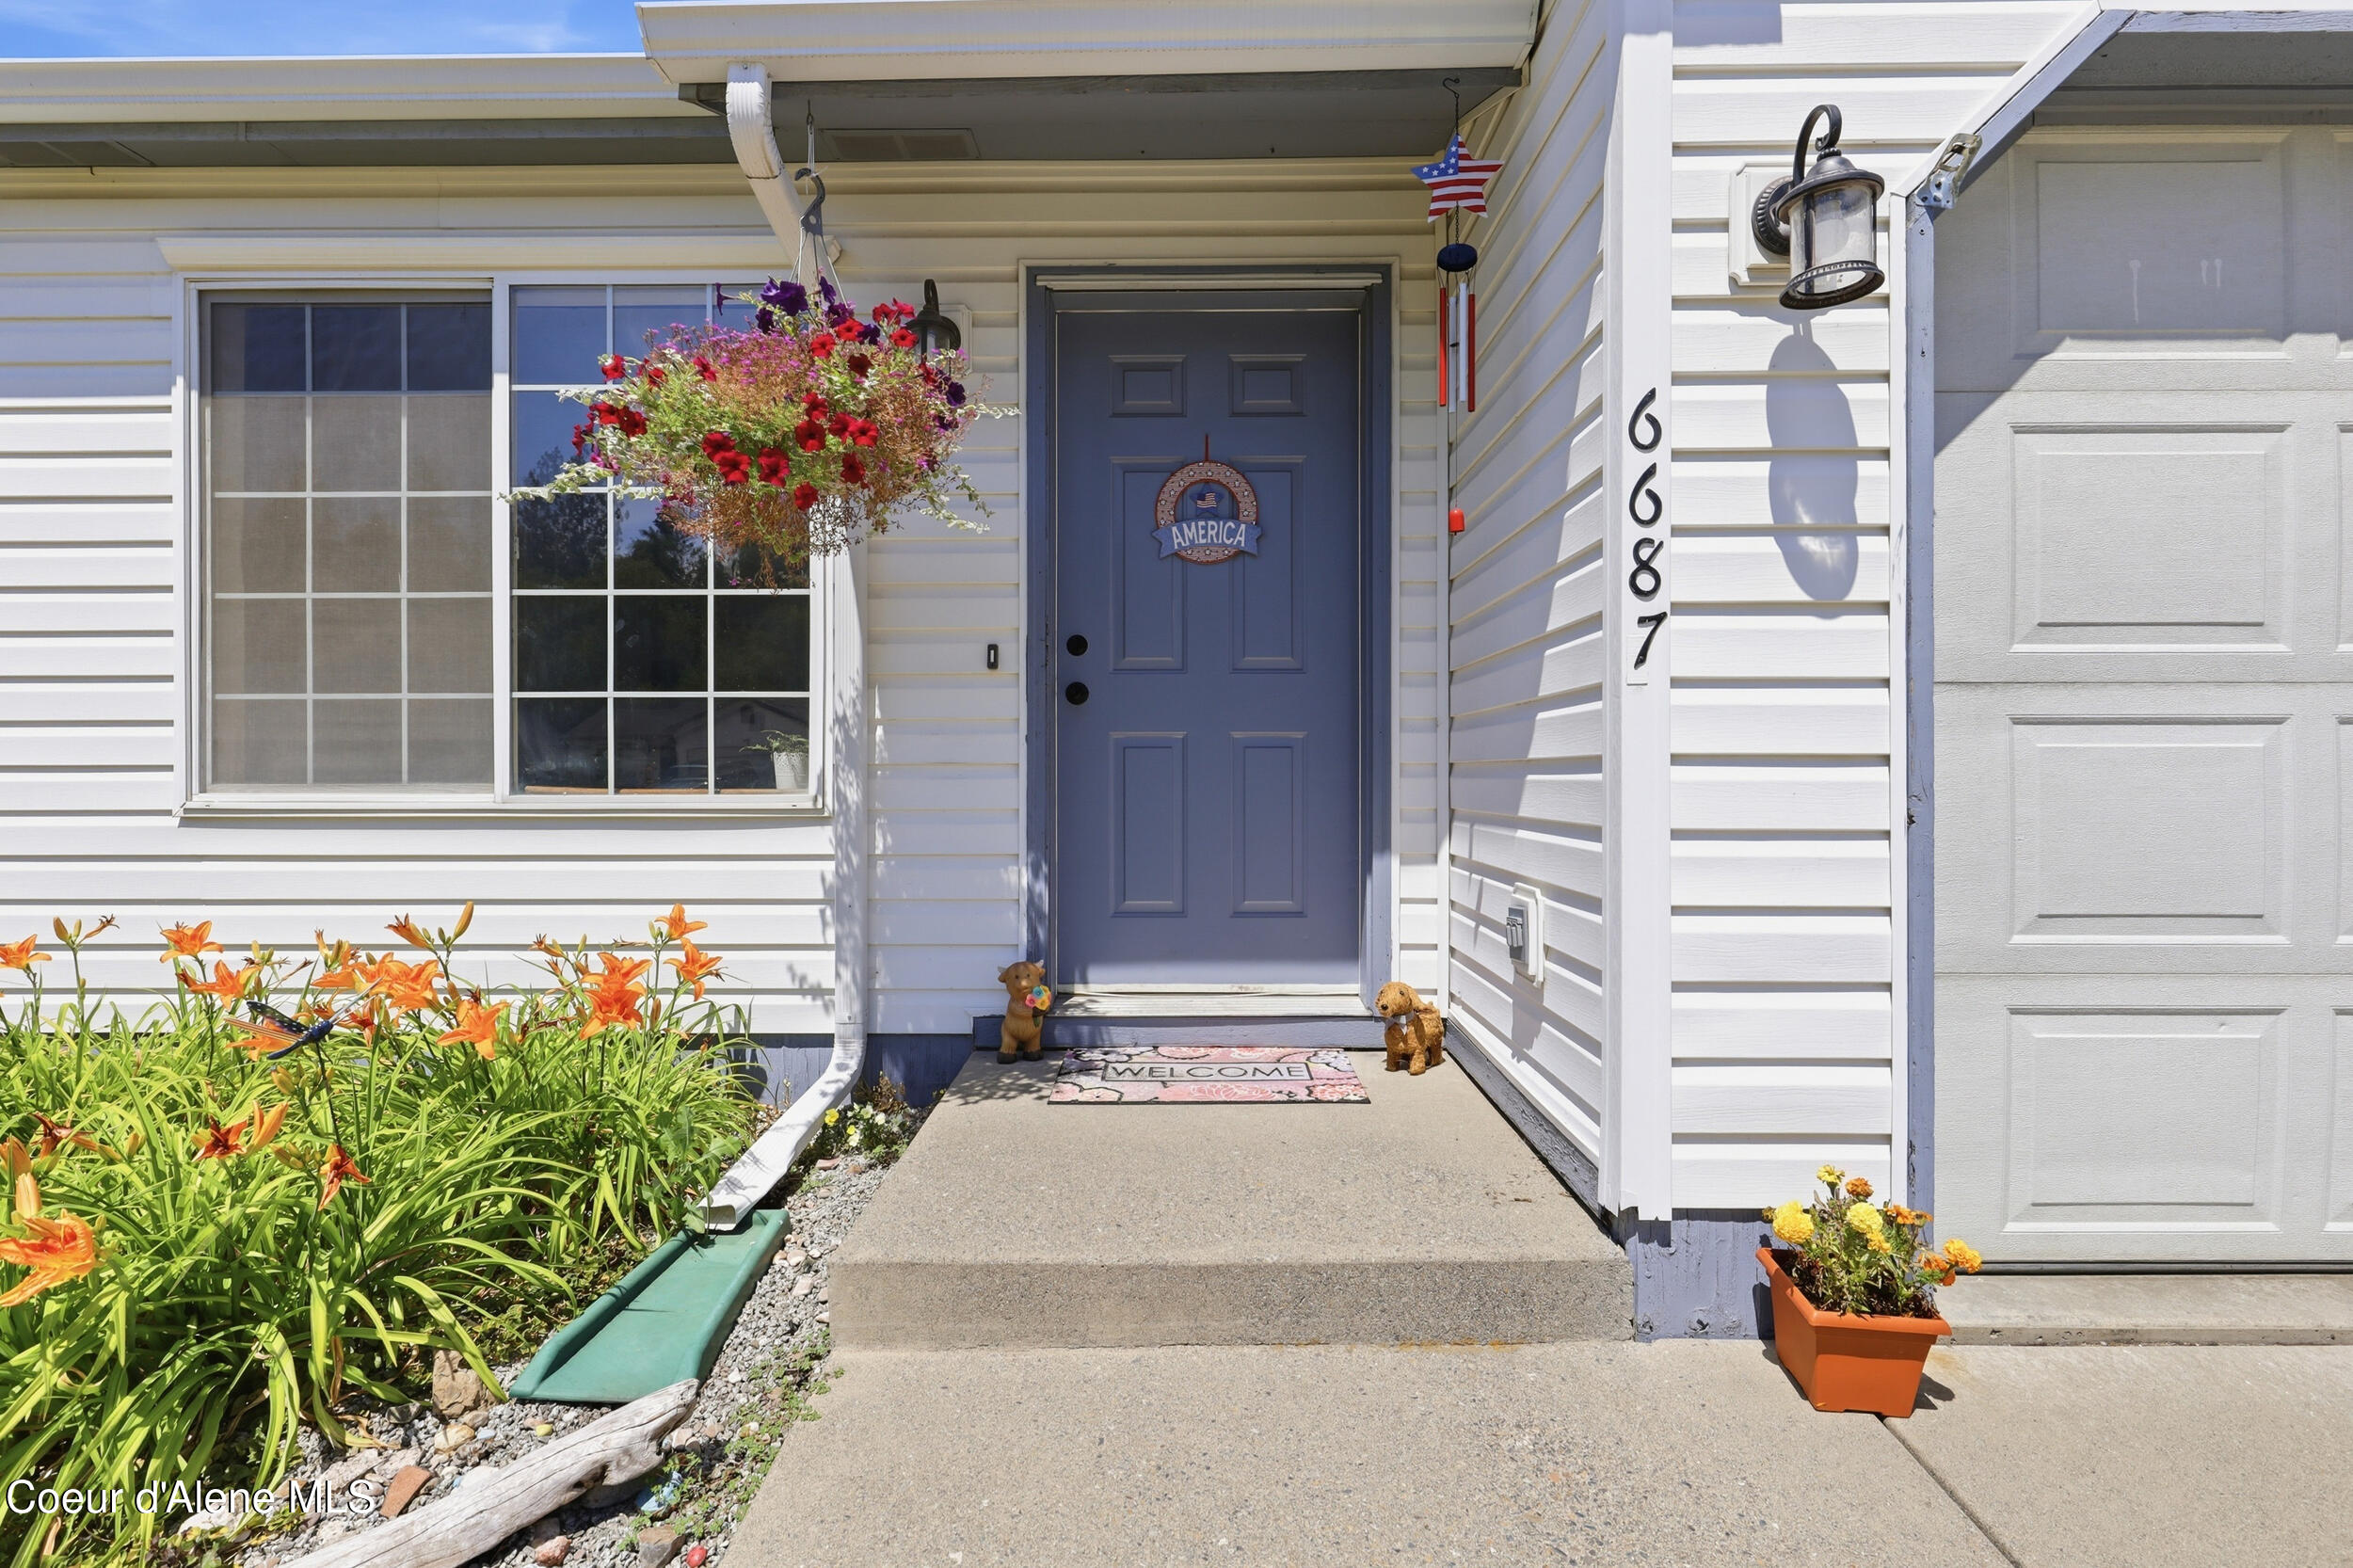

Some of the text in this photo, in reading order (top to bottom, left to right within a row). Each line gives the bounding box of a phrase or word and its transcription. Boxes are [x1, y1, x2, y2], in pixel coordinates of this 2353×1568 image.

[1172, 520, 1246, 549] AMERICA
[1628, 387, 1668, 672] 6687
[1112, 1065, 1306, 1079] WELCOME
